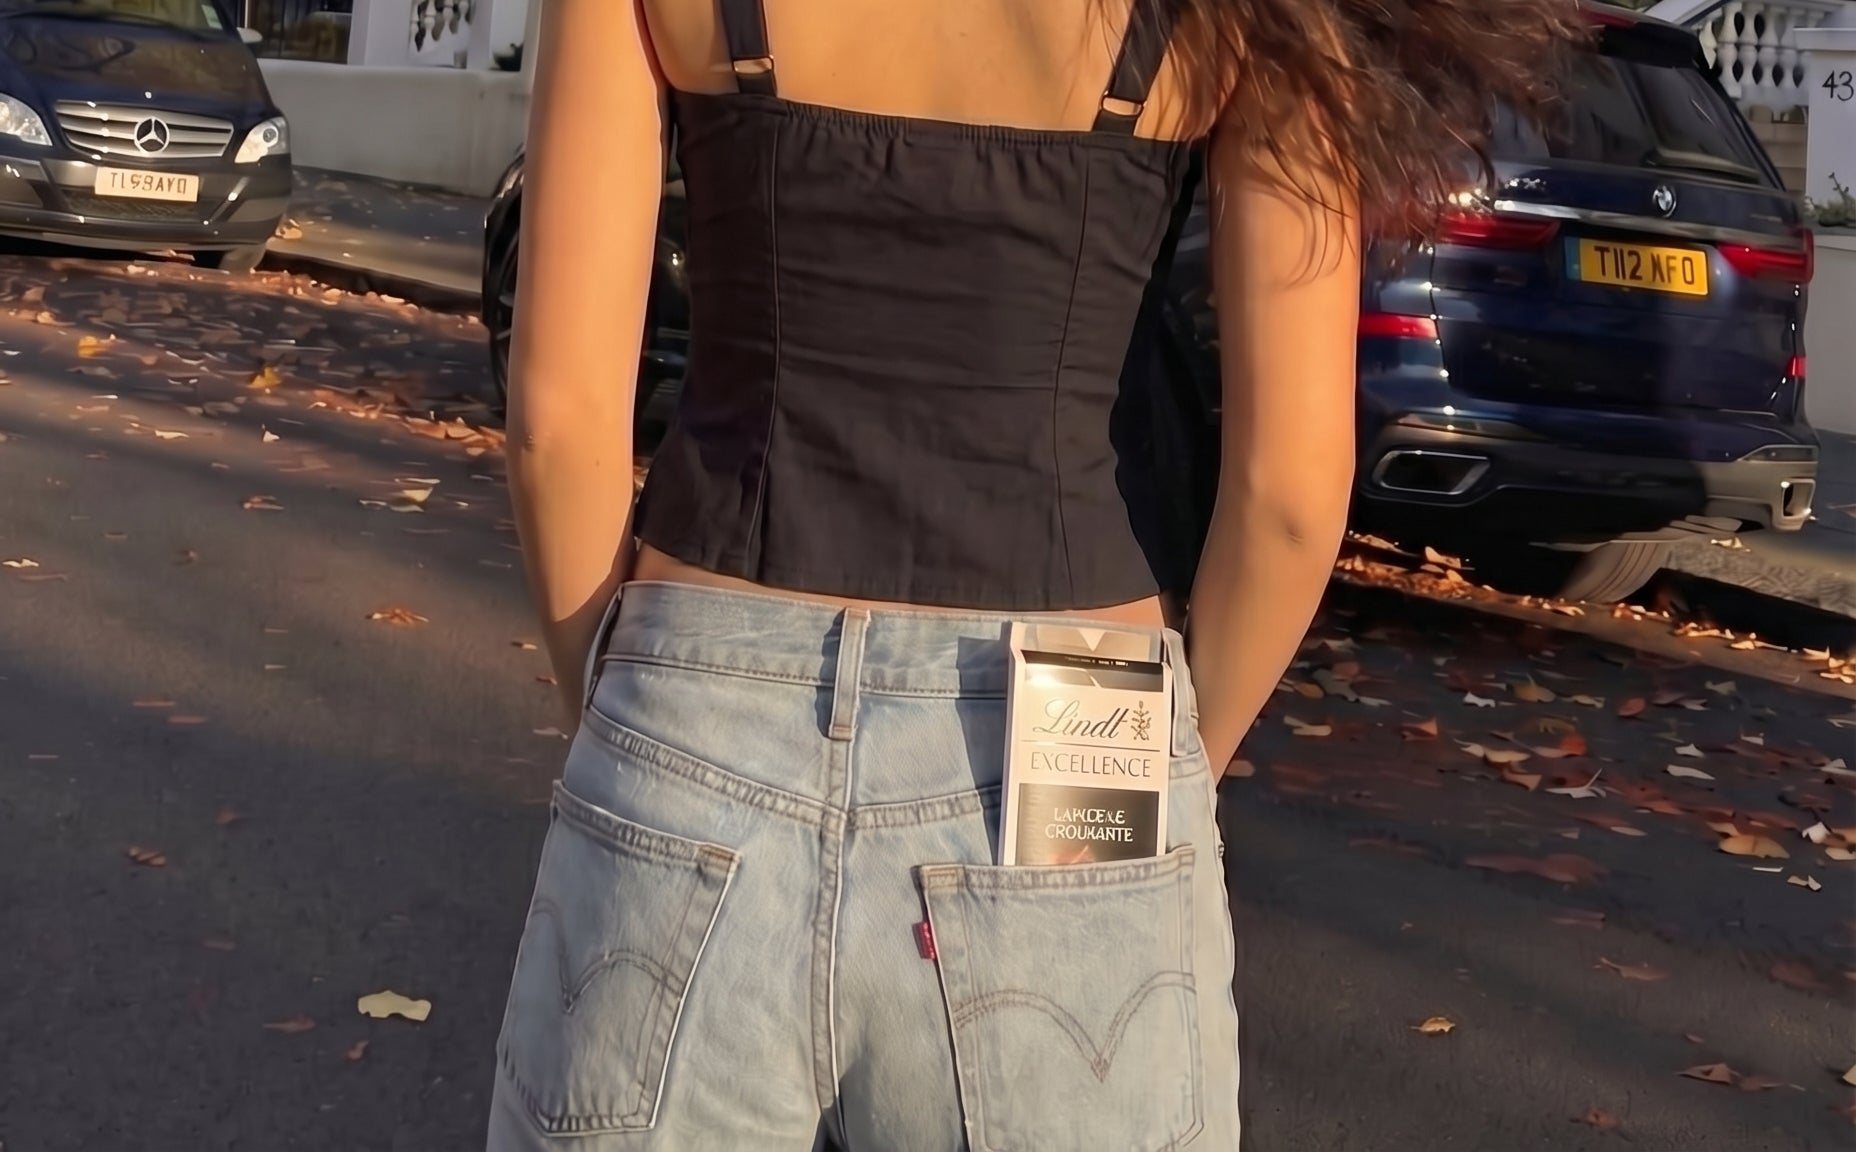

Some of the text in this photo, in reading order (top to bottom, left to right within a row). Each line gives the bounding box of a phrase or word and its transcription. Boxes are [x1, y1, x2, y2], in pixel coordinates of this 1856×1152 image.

[1822, 69, 1854, 102] 43
[1032, 697, 1129, 739] Lindt
[1030, 751, 1151, 778] EXCELLENCE
